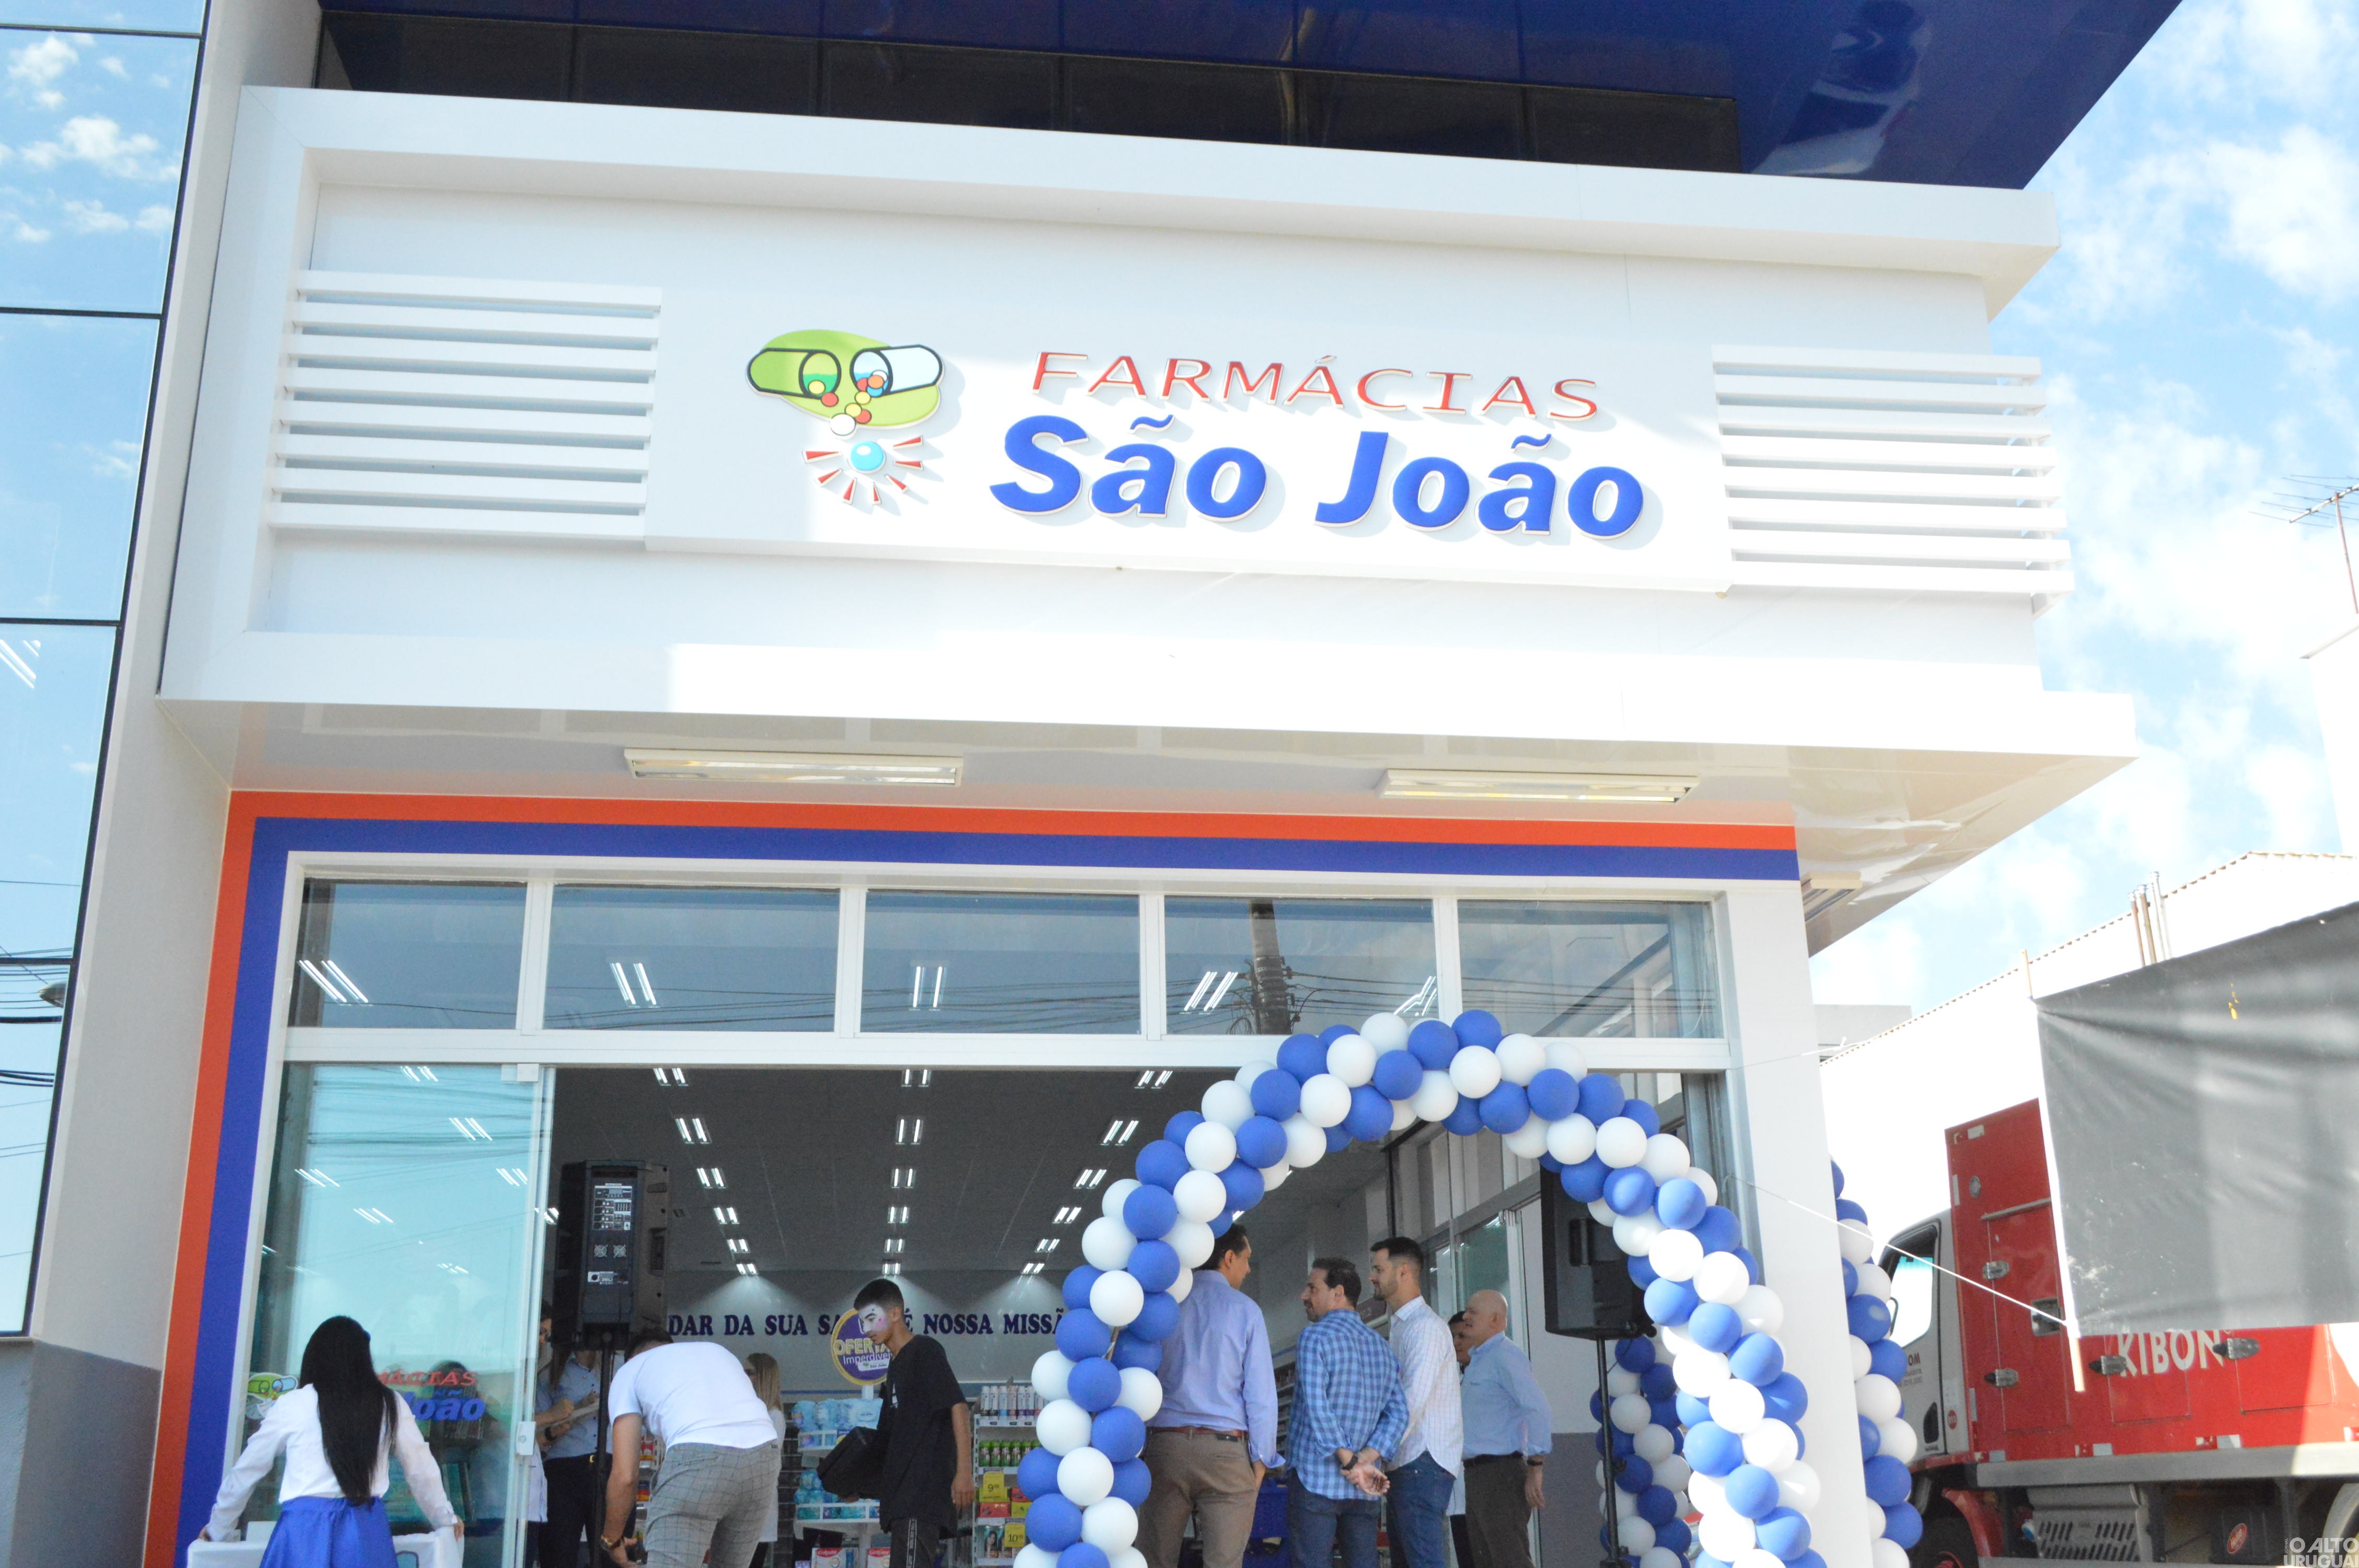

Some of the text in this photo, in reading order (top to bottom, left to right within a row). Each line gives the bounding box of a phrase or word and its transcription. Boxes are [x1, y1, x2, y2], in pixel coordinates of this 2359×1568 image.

[1032, 351, 1598, 421] FARMÁCIAS
[989, 414, 1643, 540] São João
[724, 1315, 755, 1336] DA
[764, 1315, 808, 1336] SUA
[923, 1314, 993, 1335] NOSSA
[2118, 1329, 2224, 1377] KIBON
